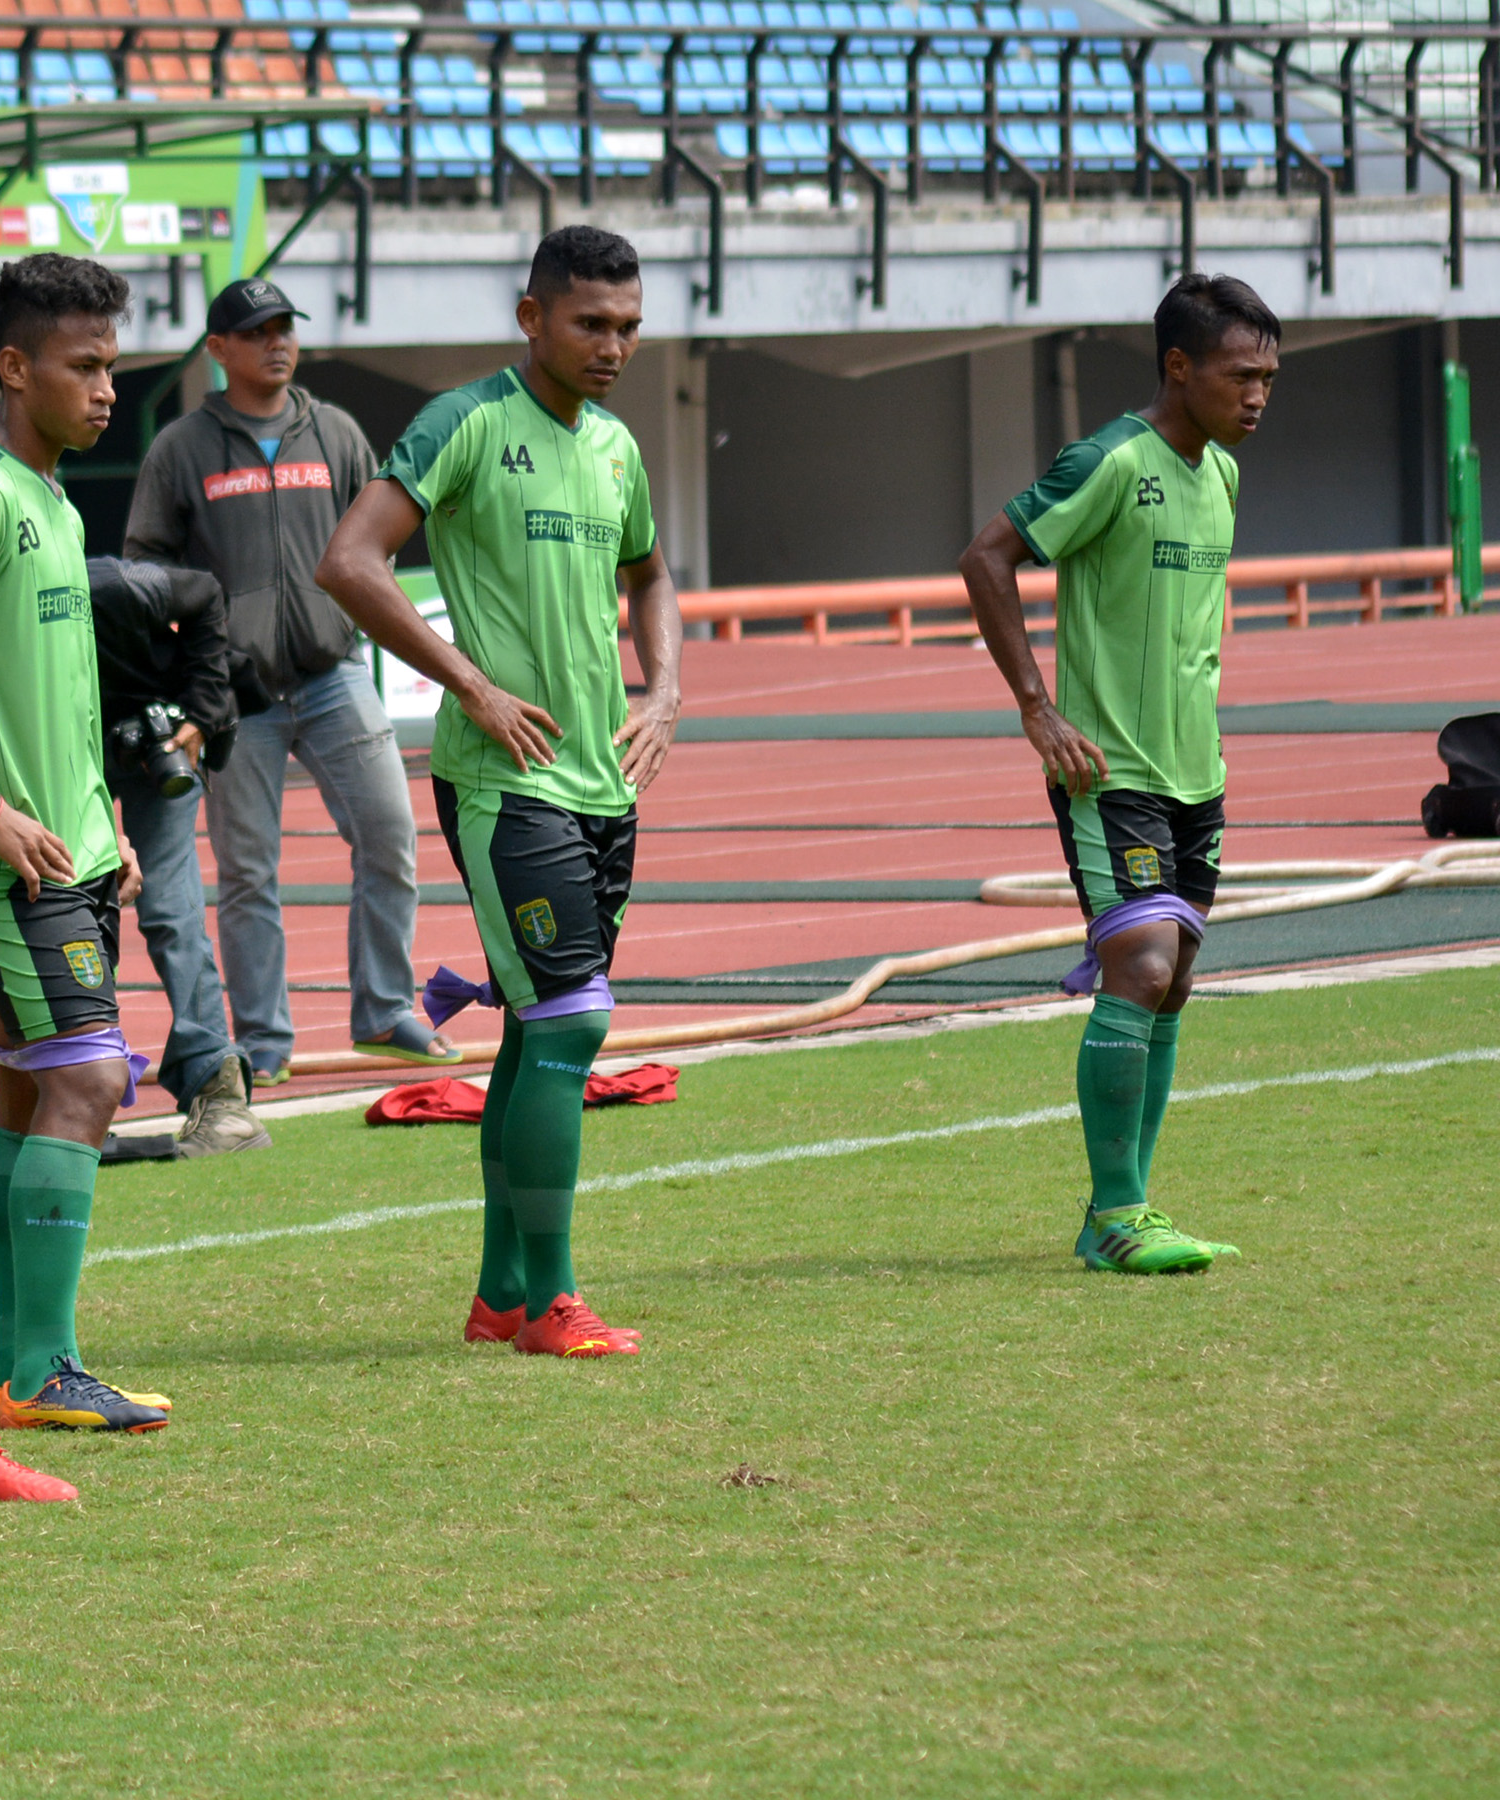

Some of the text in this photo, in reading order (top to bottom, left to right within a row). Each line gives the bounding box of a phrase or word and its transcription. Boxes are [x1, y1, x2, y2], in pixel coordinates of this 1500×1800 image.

[501, 444, 535, 474] 44
[1138, 476, 1165, 507] 25
[18, 517, 41, 556] 20
